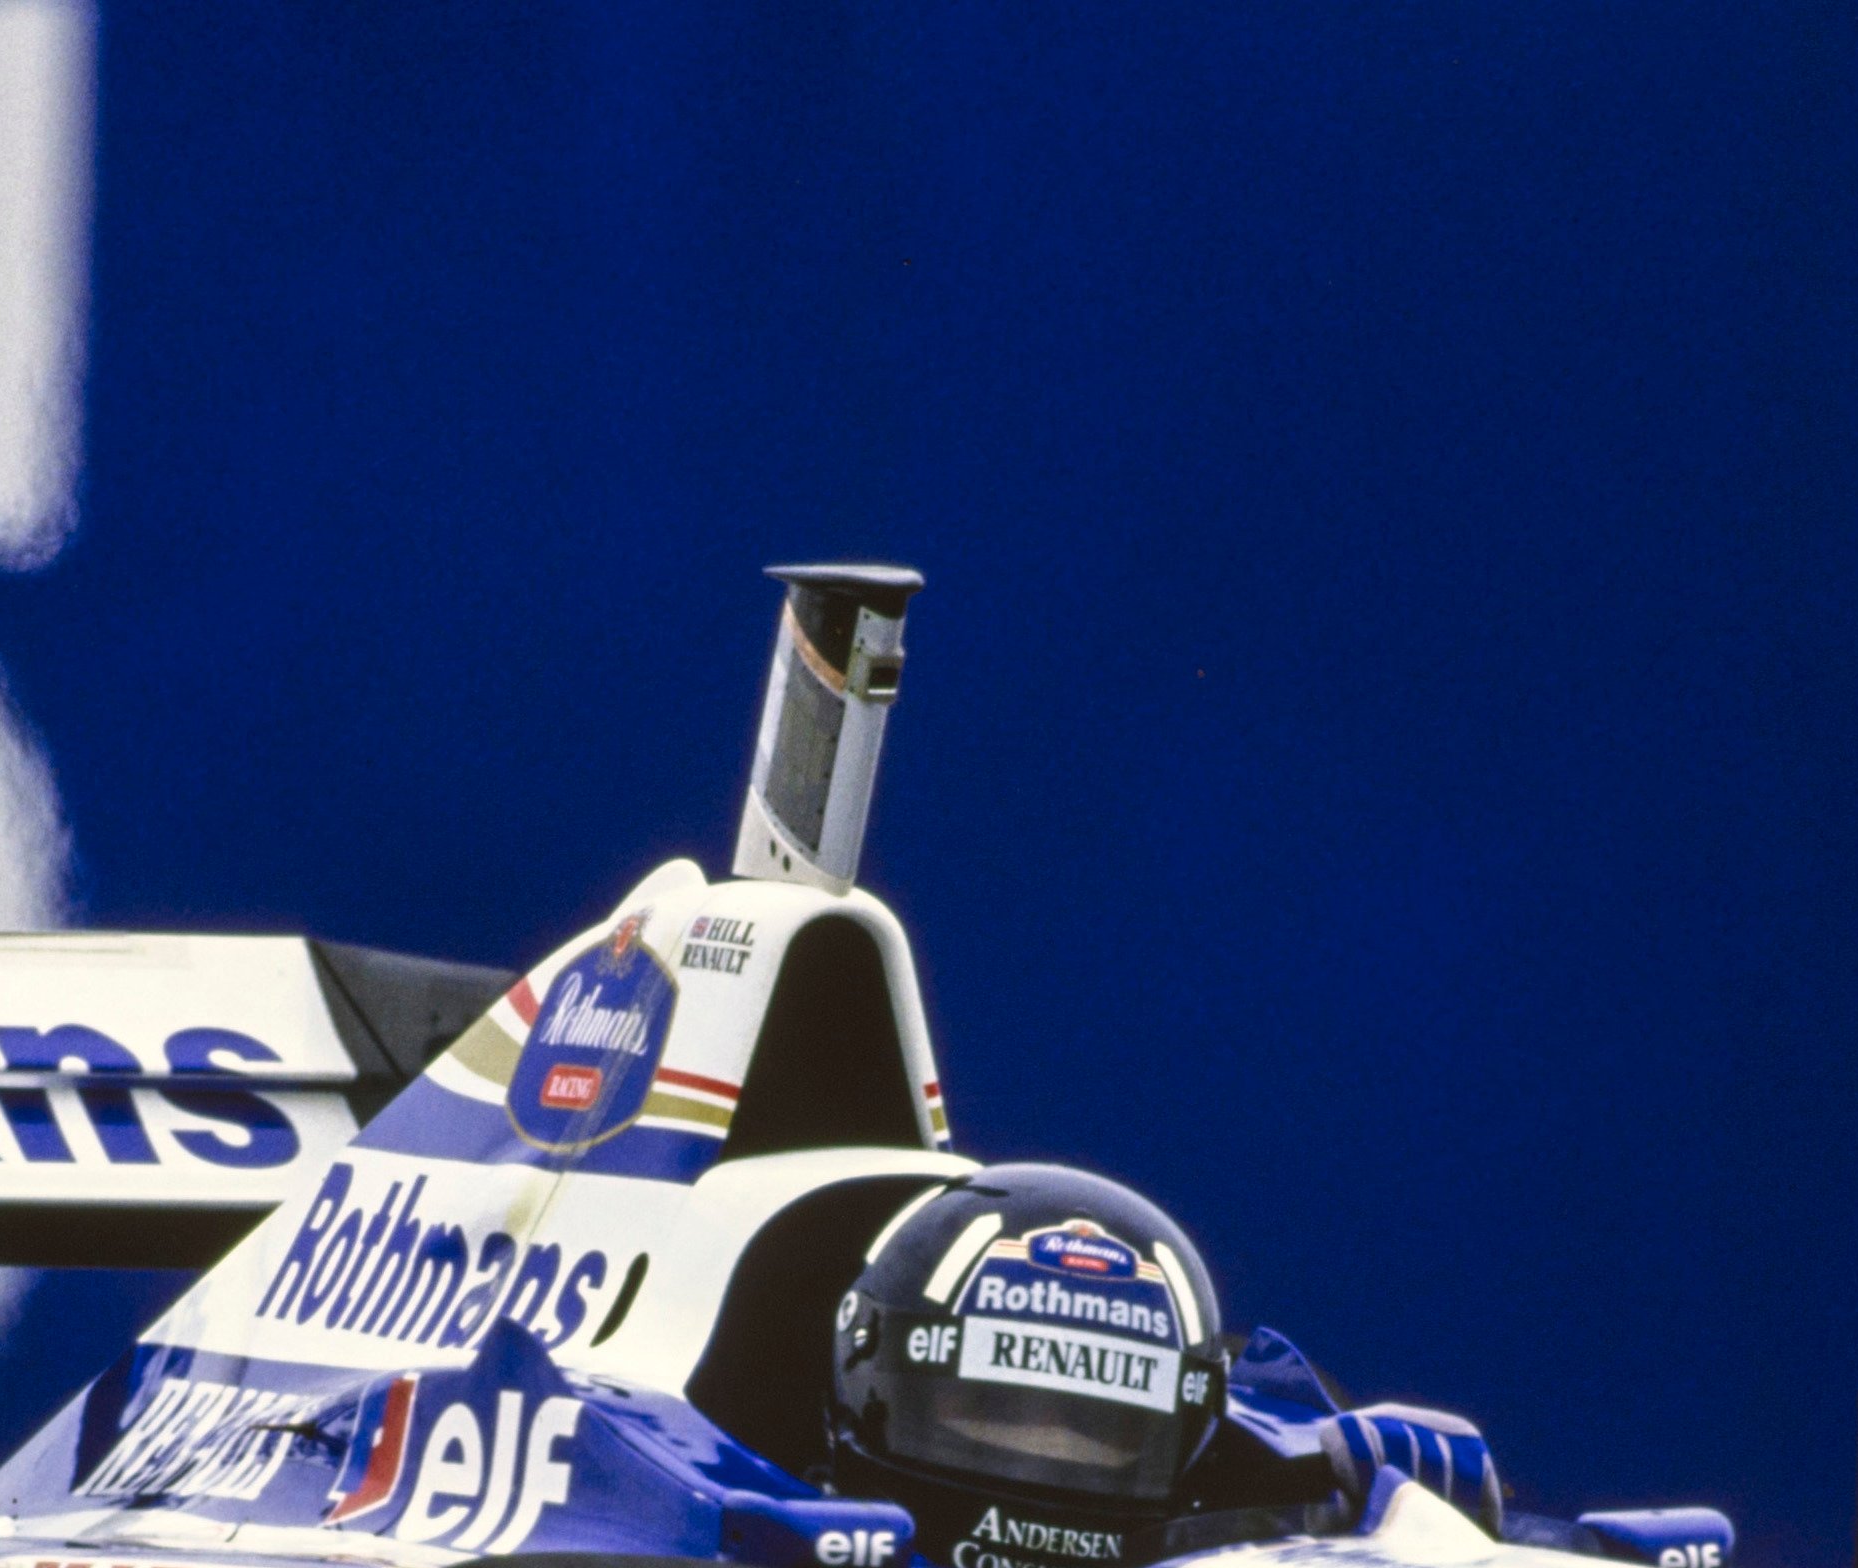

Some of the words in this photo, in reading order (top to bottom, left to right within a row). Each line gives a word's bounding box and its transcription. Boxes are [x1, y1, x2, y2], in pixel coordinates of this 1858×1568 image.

[706, 916, 755, 947] HILL
[680, 942, 751, 976] RENAULT
[541, 970, 648, 1056] Rothmans
[254, 1162, 608, 1352] Rothmans
[975, 1276, 1171, 1339] Rothmans
[907, 1324, 958, 1364] elf
[990, 1331, 1159, 1394] RENAULT
[1182, 1370, 1210, 1405] elf
[395, 1390, 586, 1556] elf
[815, 1531, 896, 1567] elf
[972, 1505, 1123, 1559] ANDERSEN
